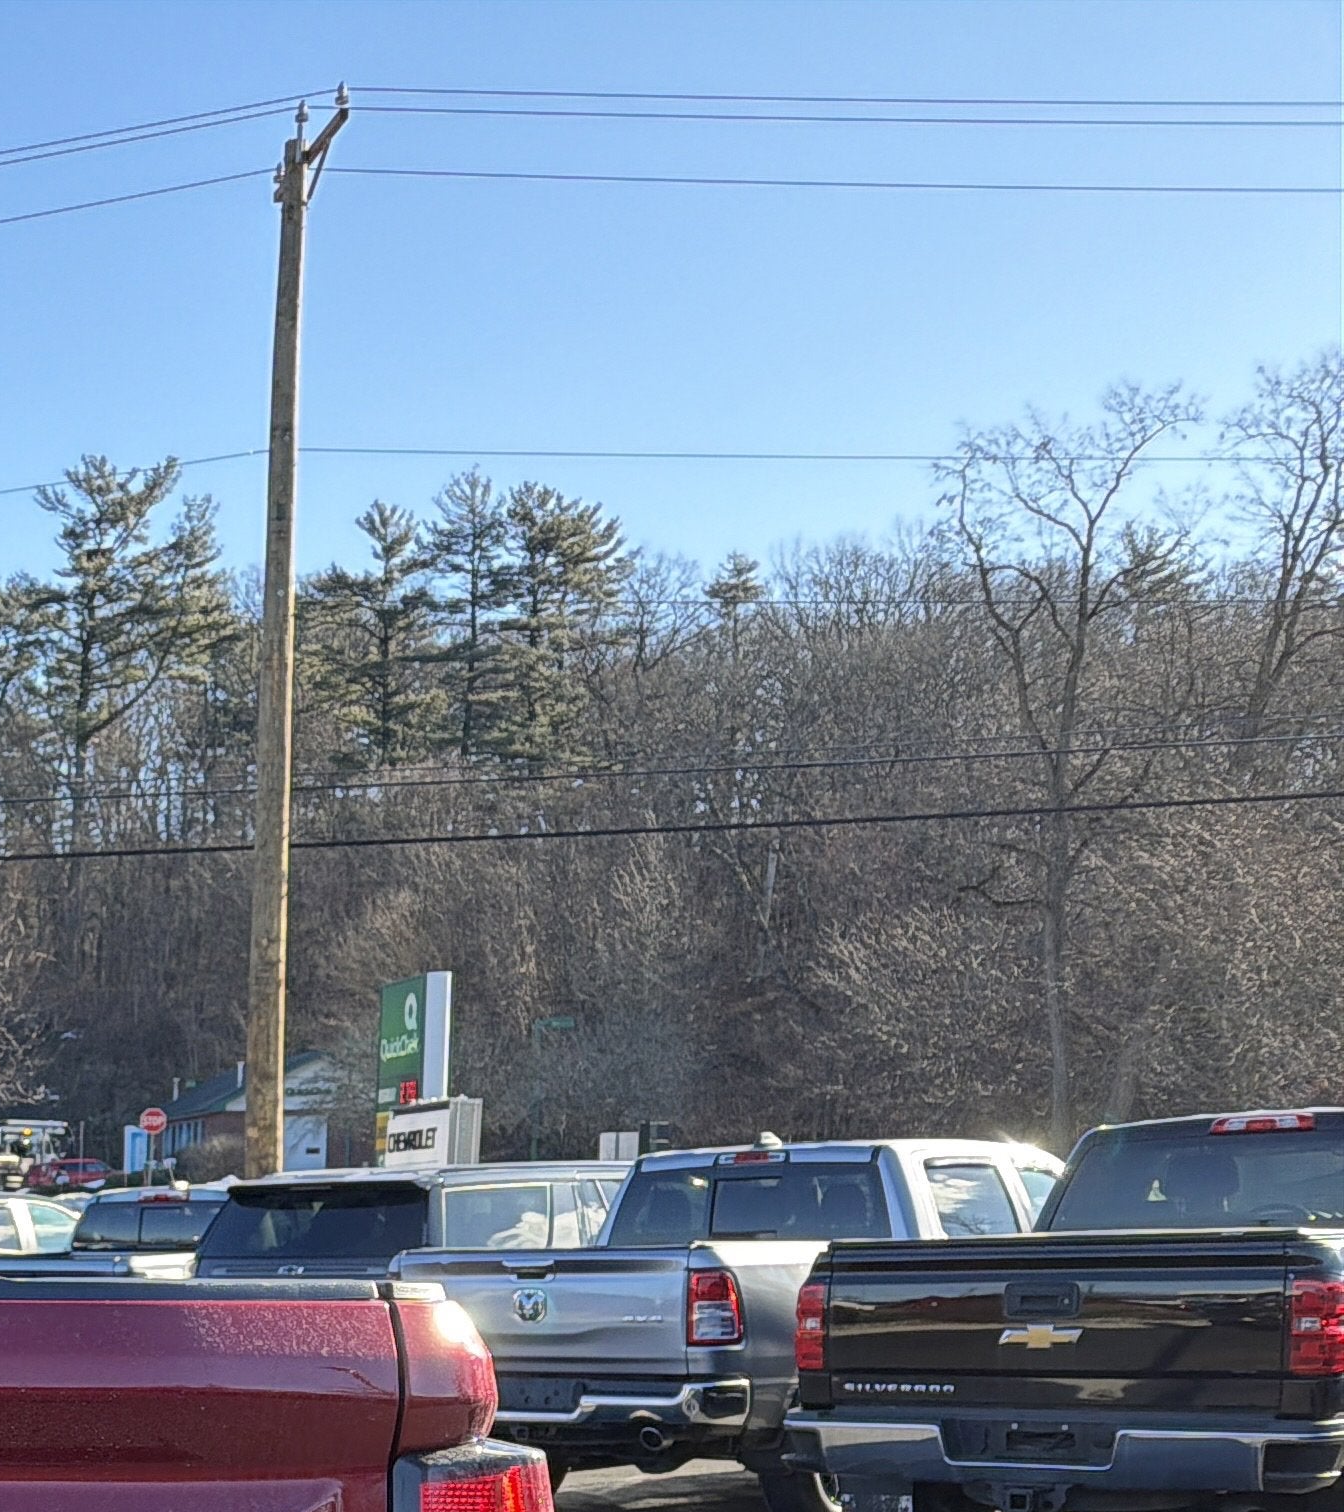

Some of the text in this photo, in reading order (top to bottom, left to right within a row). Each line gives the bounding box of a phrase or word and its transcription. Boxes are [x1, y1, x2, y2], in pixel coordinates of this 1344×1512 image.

[143, 1115, 164, 1127] STOP
[388, 1127, 437, 1153] CHEVROLET
[843, 1382, 955, 1393] SILVERADO
